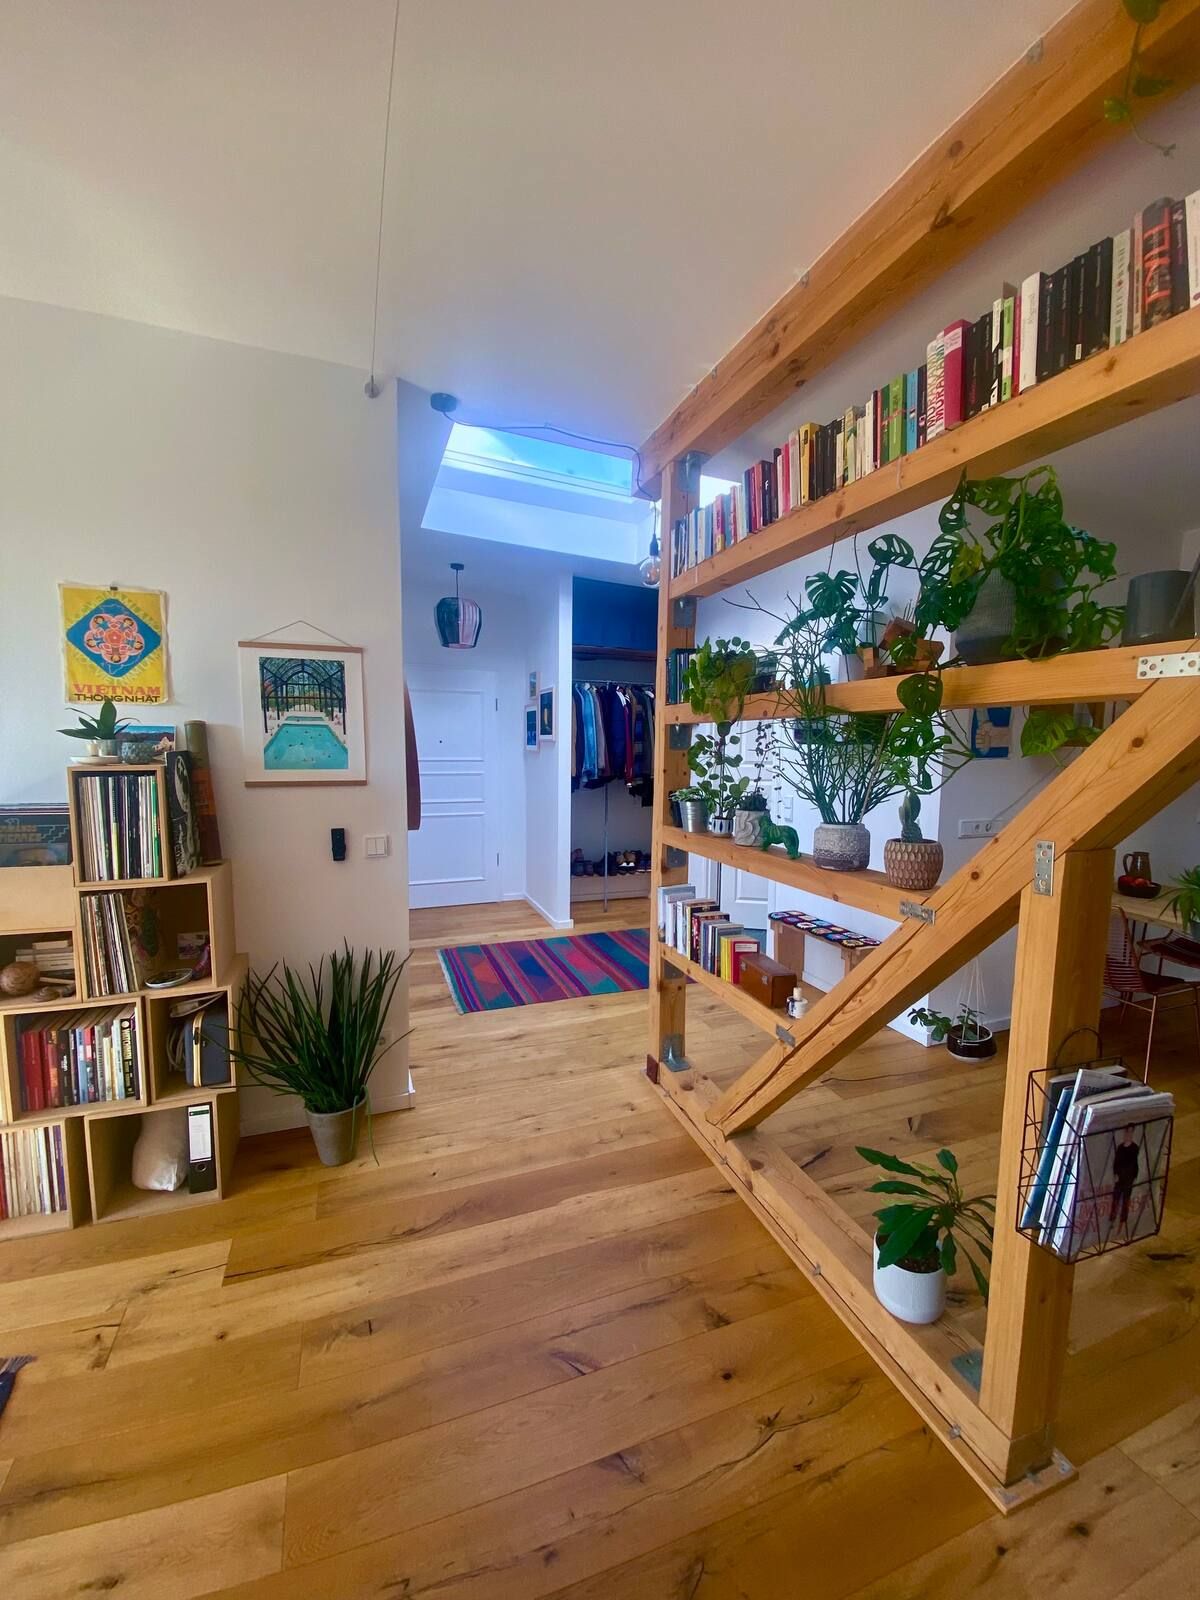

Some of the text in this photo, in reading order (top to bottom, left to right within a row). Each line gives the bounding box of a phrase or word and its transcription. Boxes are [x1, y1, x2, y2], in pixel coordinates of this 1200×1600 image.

[927, 351, 937, 428] MURAKAMI
[935, 344, 945, 421] MURAKAMI
[73, 684, 160, 695] VIETNAM
[121, 1028, 132, 1060] WATCHMEN
